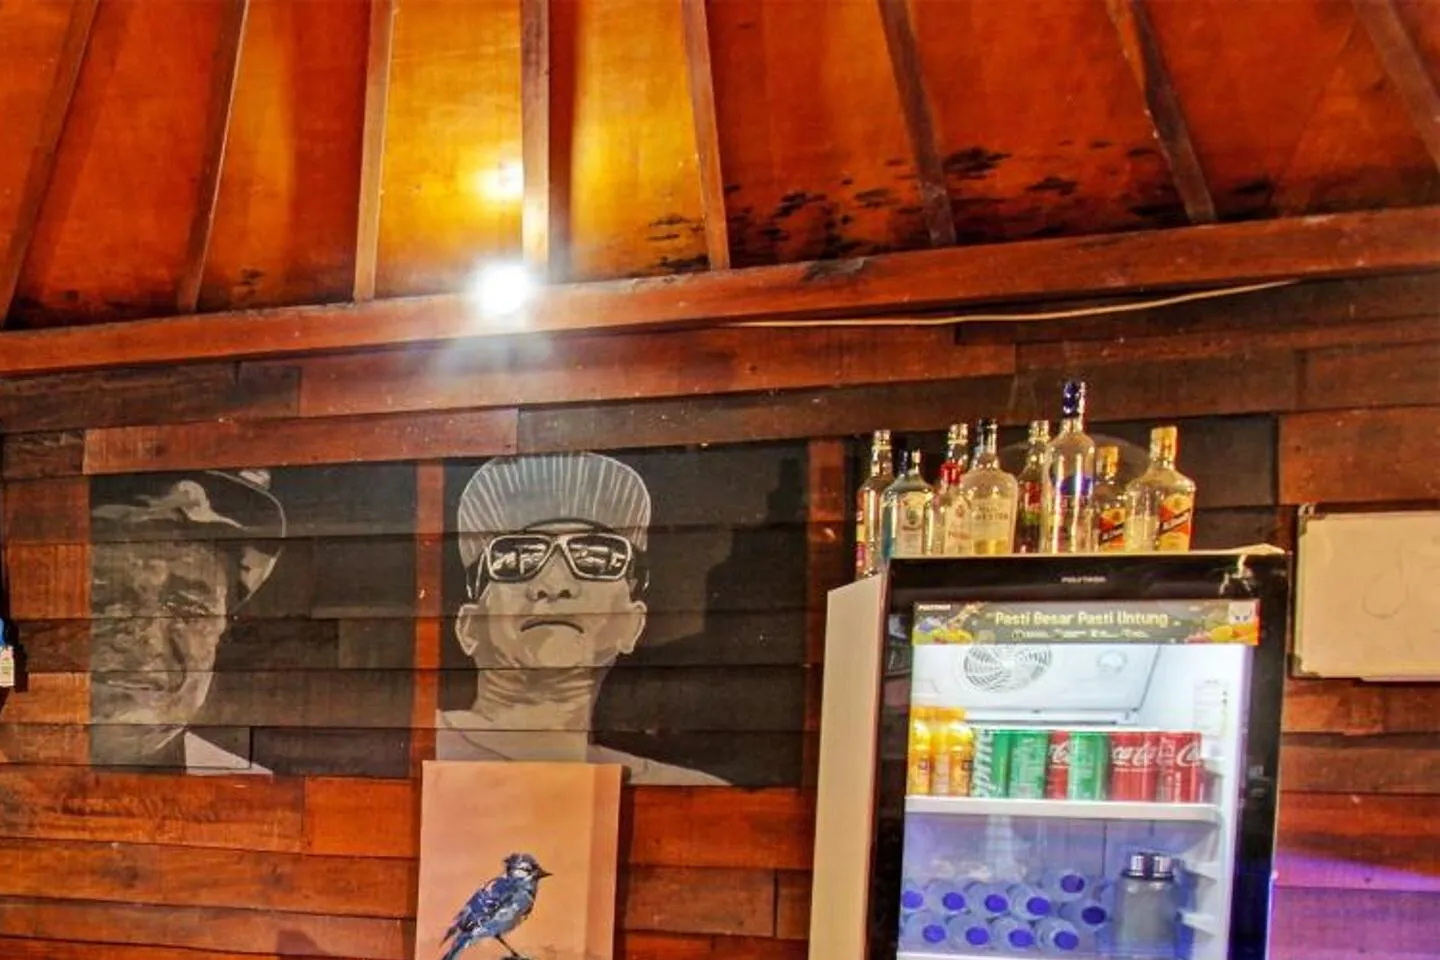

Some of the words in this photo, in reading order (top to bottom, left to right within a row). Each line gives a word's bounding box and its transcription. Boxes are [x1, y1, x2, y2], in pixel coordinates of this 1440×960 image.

[995, 611, 1030, 625] Pasti
[1033, 611, 1074, 625] Besar
[1078, 611, 1114, 625] Pasti
[1117, 612, 1169, 628] Untung
